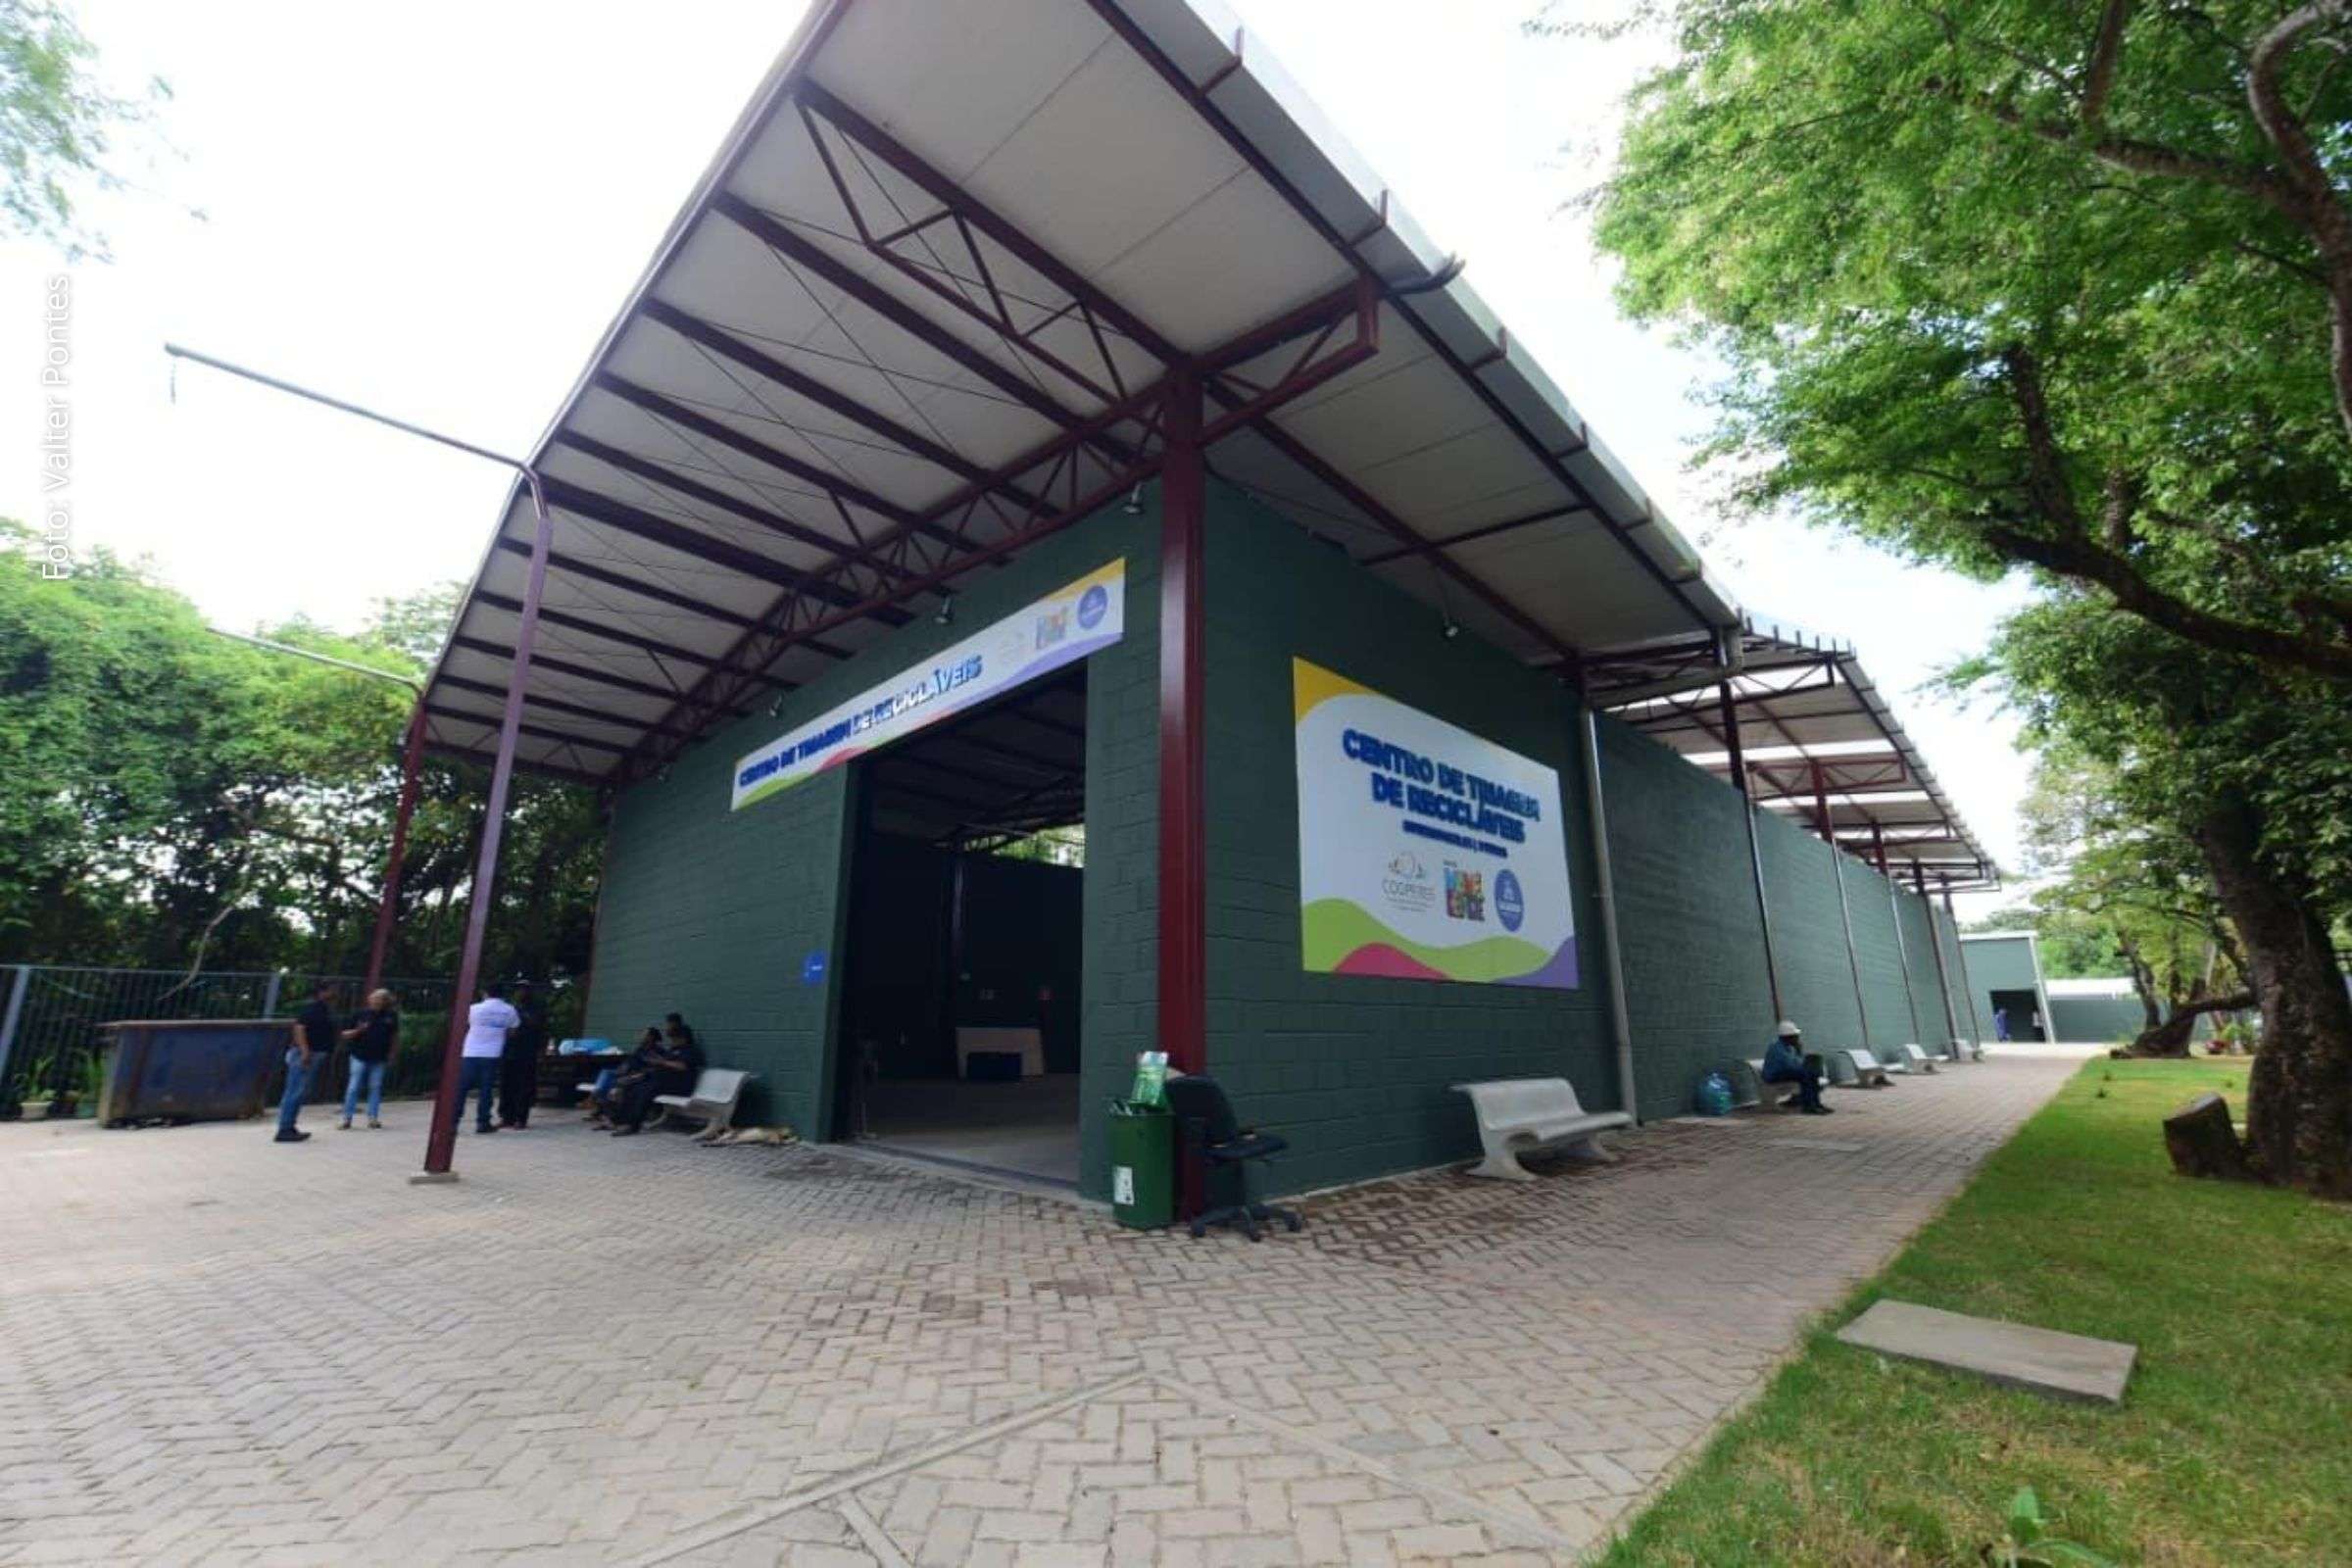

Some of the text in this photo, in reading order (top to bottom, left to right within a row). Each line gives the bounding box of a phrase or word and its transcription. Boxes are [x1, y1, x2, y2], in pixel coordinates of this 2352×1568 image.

[873, 654, 983, 723] CICLÁVEIS
[1343, 728, 1435, 785] CENTRO
[1437, 762, 1465, 796] DE
[1371, 771, 1404, 808] DE
